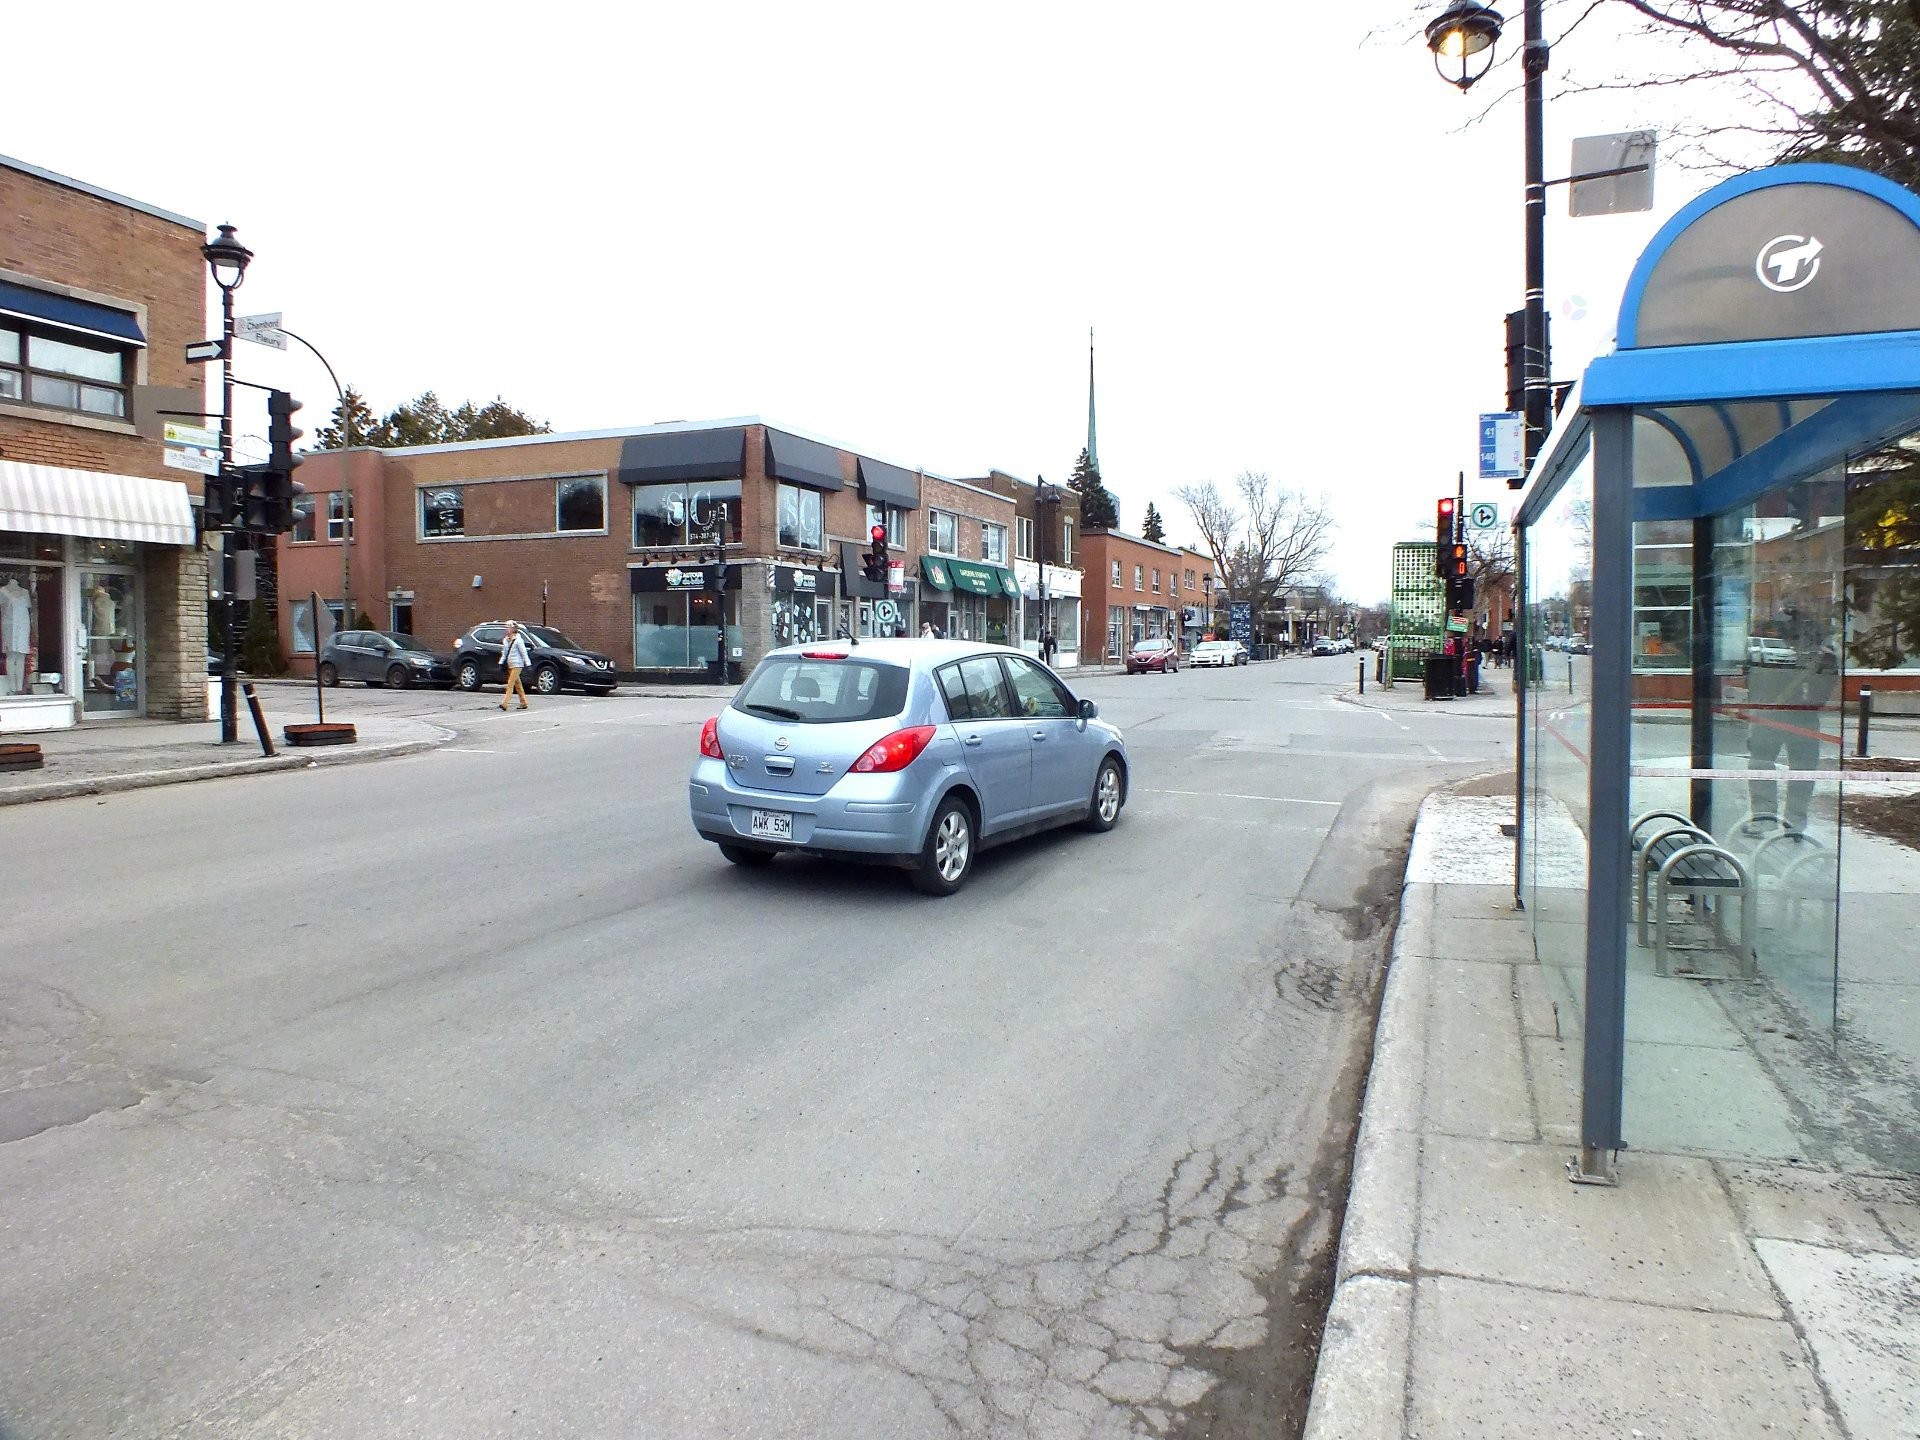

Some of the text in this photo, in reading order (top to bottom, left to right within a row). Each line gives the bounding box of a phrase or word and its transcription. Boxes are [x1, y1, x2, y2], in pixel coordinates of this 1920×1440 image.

[256, 332, 280, 348] Fleury
[1484, 427, 1495, 436] 41
[753, 815, 790, 833] AWK 53M
